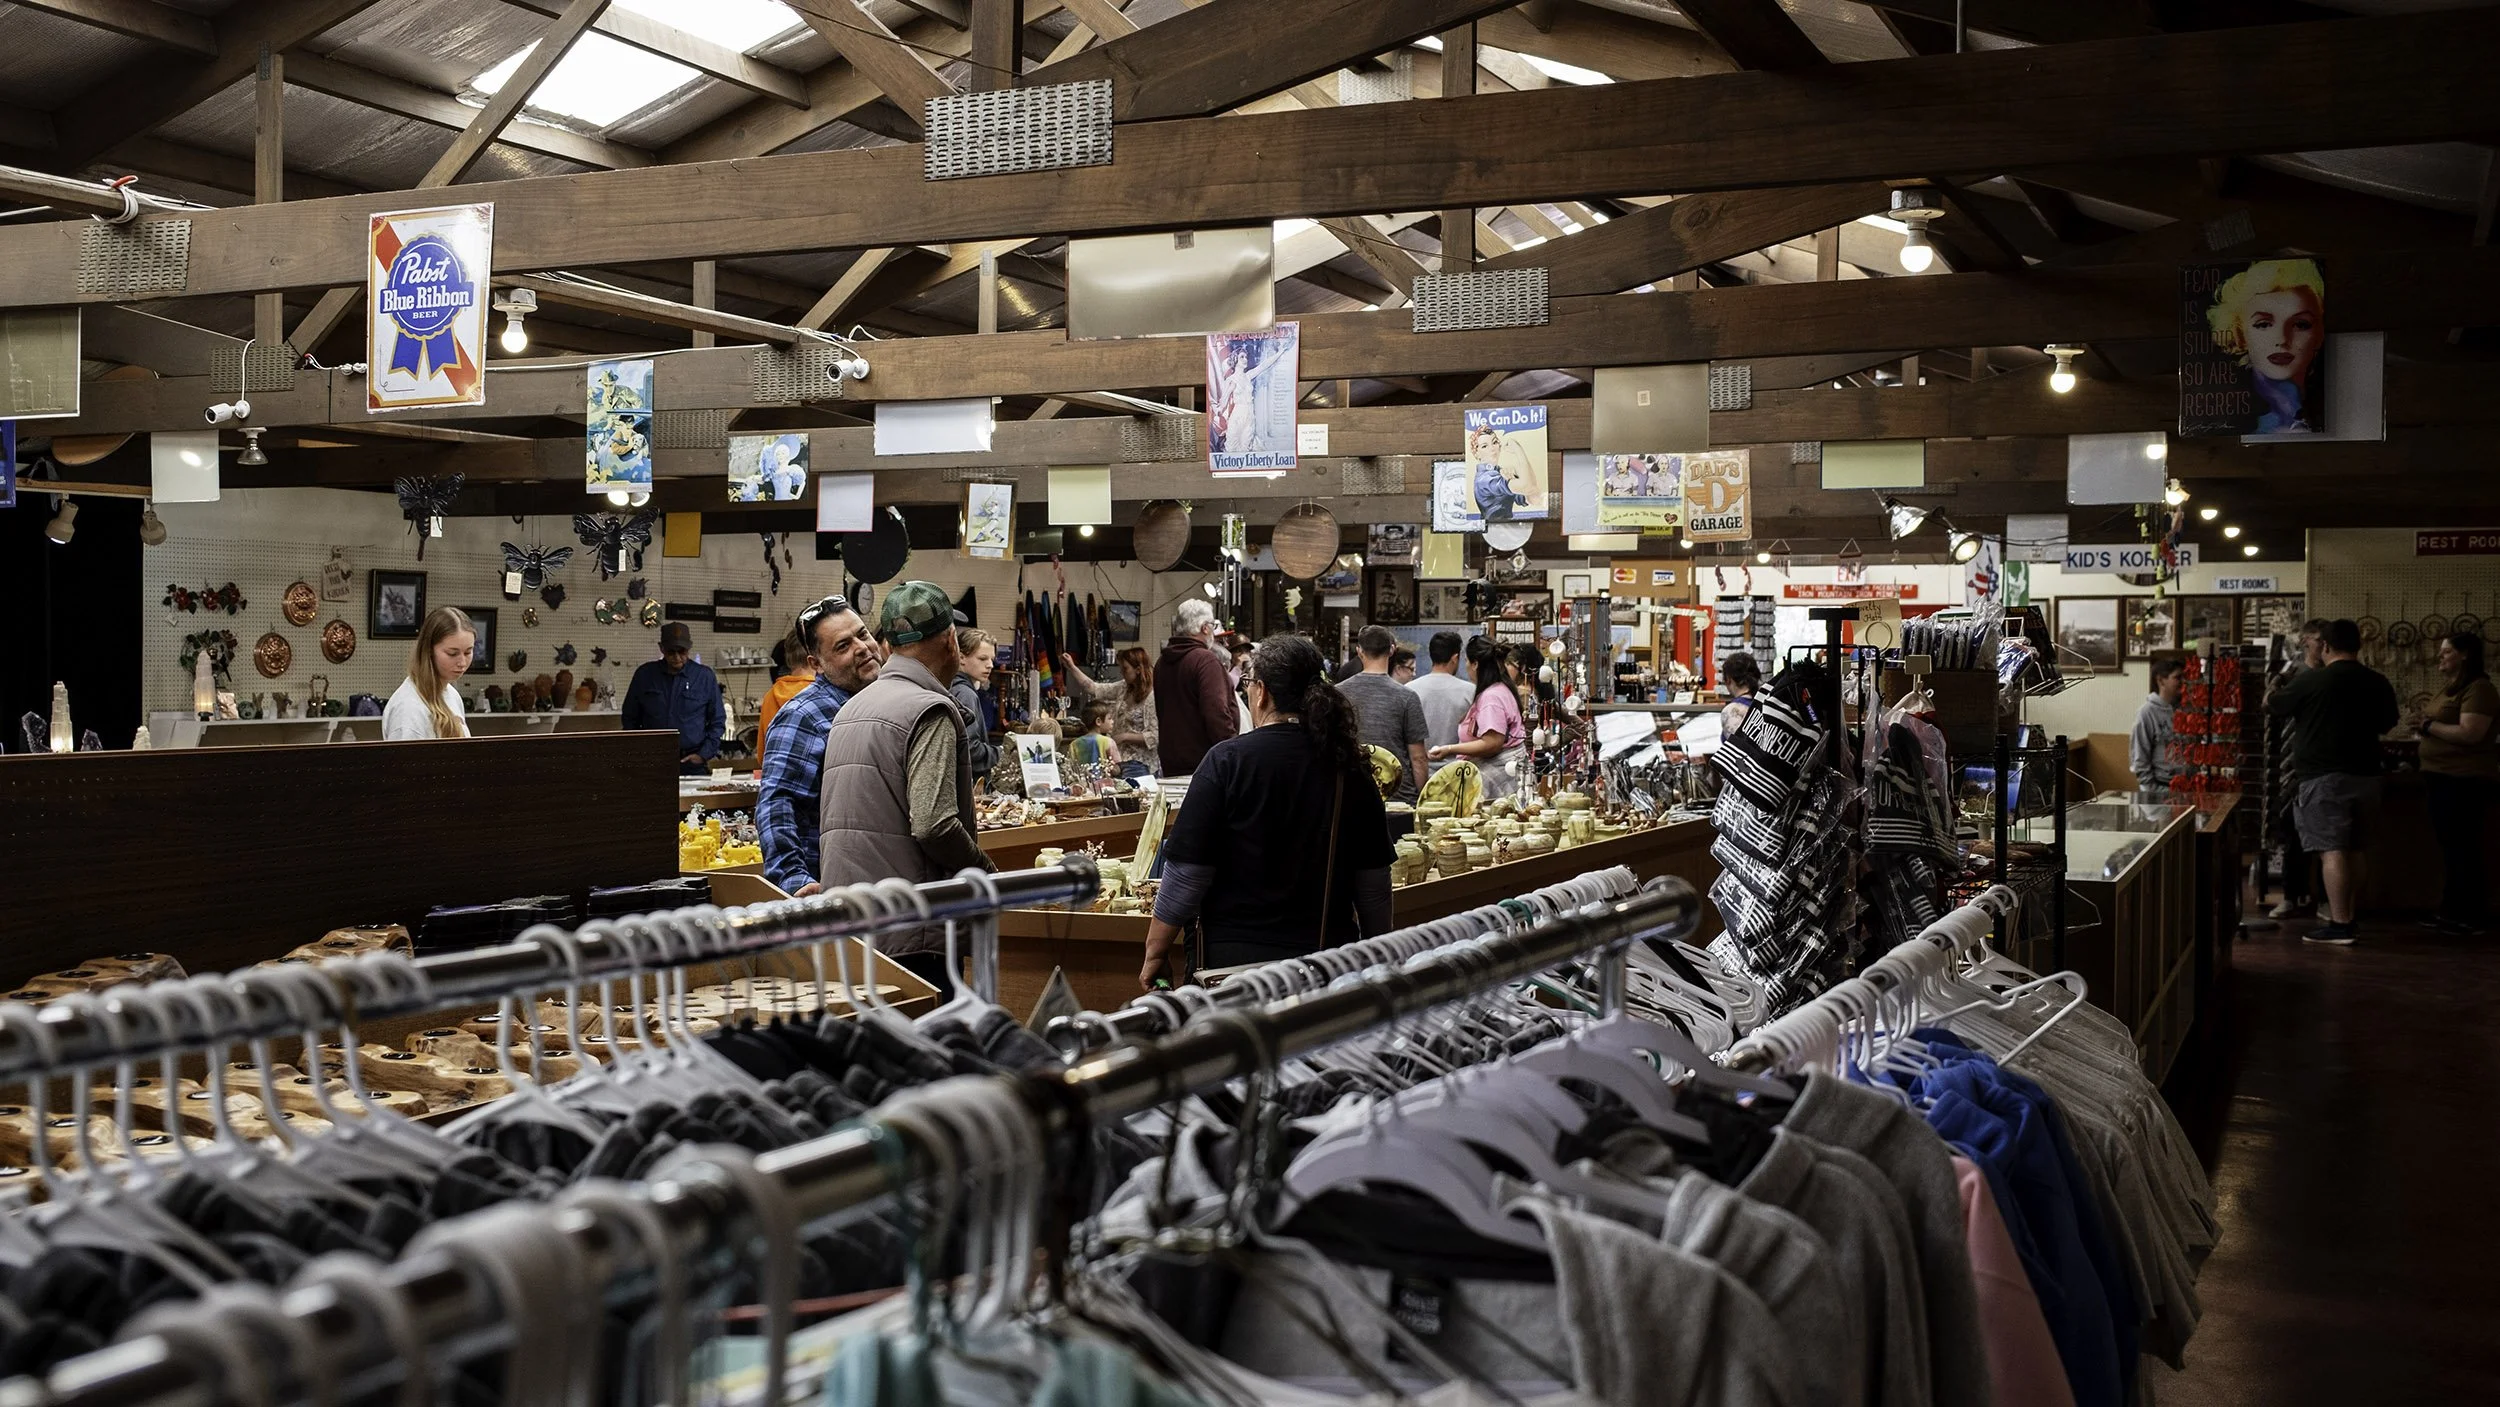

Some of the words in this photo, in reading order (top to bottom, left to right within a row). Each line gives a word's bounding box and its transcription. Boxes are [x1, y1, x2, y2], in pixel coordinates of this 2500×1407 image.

[401, 251, 450, 285] Pabst
[2184, 268, 2220, 293] FEAR
[382, 289, 415, 313] Blue
[416, 285, 471, 309] Ribbon
[412, 310, 439, 319] BEER
[2184, 300, 2198, 325] IS
[2184, 329, 2234, 356] STUPID
[2184, 361, 2204, 386] SO
[2208, 360, 2238, 384] ARE
[2185, 390, 2250, 417] REGRETS
[1469, 412, 1488, 427] We
[1488, 411, 1511, 425] Can
[1512, 410, 1529, 425] Do
[1530, 408, 1543, 423] It!
[1213, 453, 1245, 469] Victory
[1245, 453, 1275, 468] Liberty
[1275, 452, 1295, 466] Loan
[1690, 460, 1740, 481] DAD'S
[1691, 516, 1742, 531] GARAGE
[2418, 536, 2460, 549] REST
[2468, 535, 2500, 548] ROO
[2067, 552, 2111, 568] KID'S
[2120, 551, 2192, 567] KORER
[2219, 578, 2240, 590] REST
[2241, 578, 2270, 589] ROOMS
